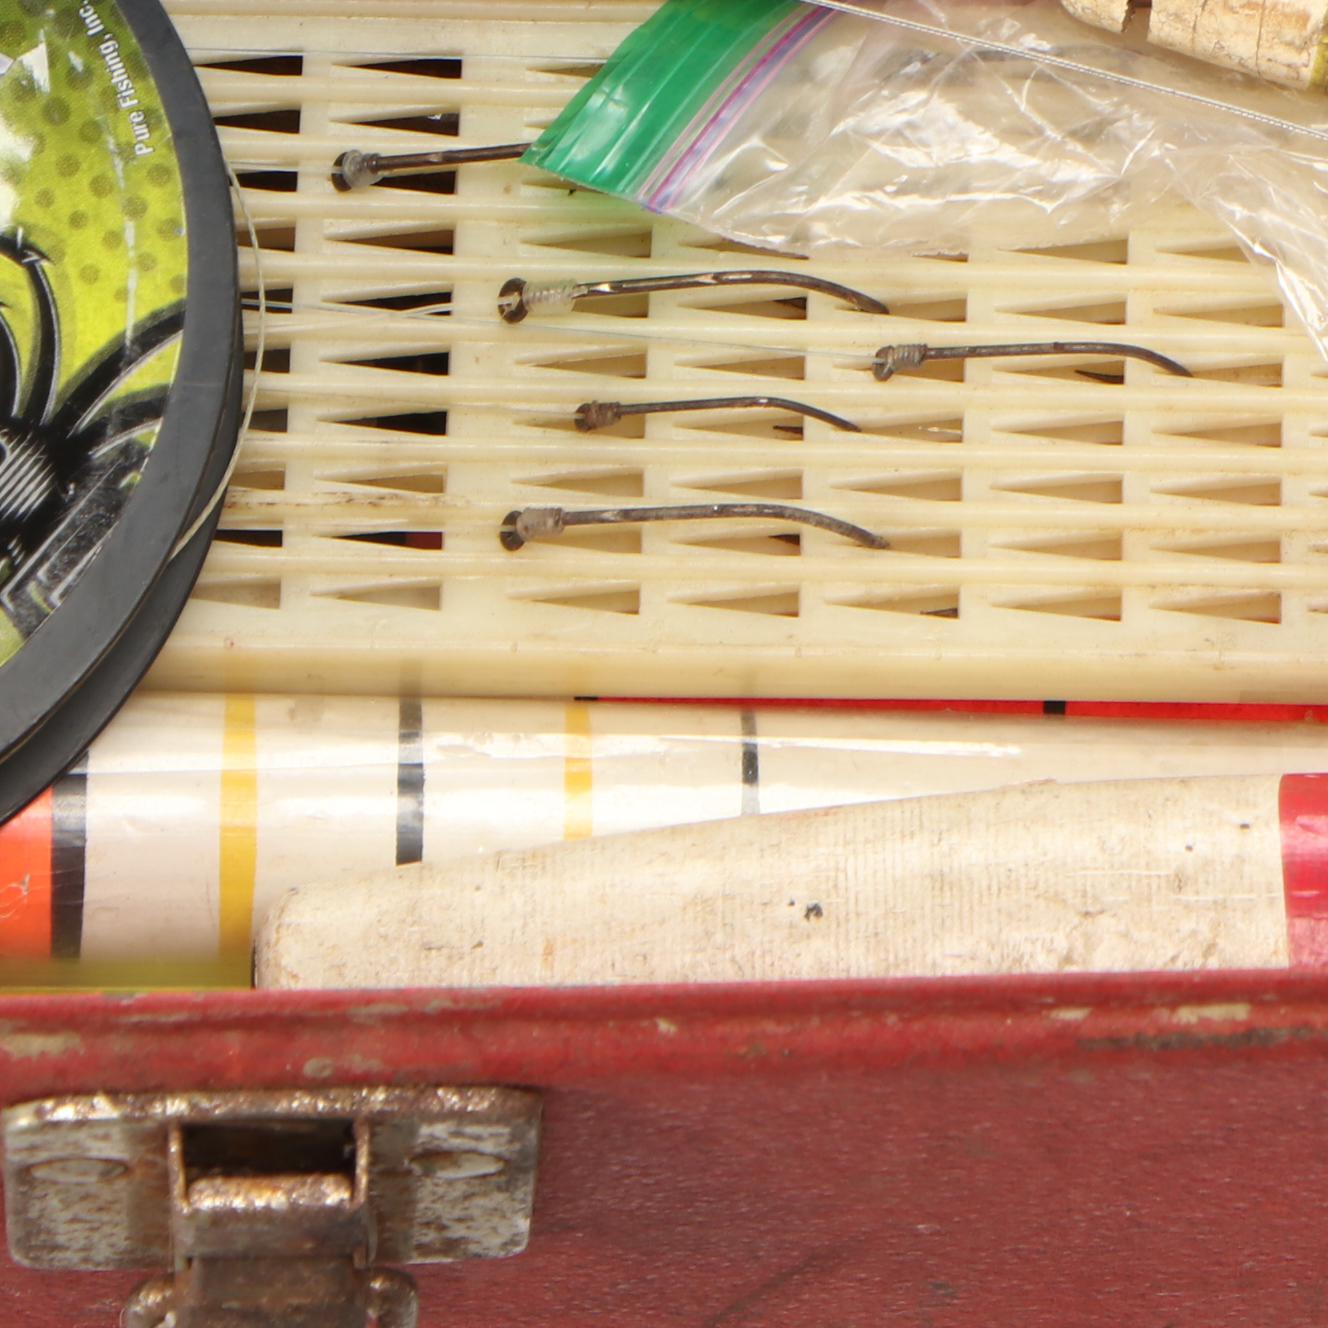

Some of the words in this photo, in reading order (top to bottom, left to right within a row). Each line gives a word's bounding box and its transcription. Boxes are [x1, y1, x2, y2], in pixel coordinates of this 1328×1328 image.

[79, 0, 104, 36] Inc.
[99, 33, 139, 109] Fishing,
[128, 110, 155, 157] Pure
